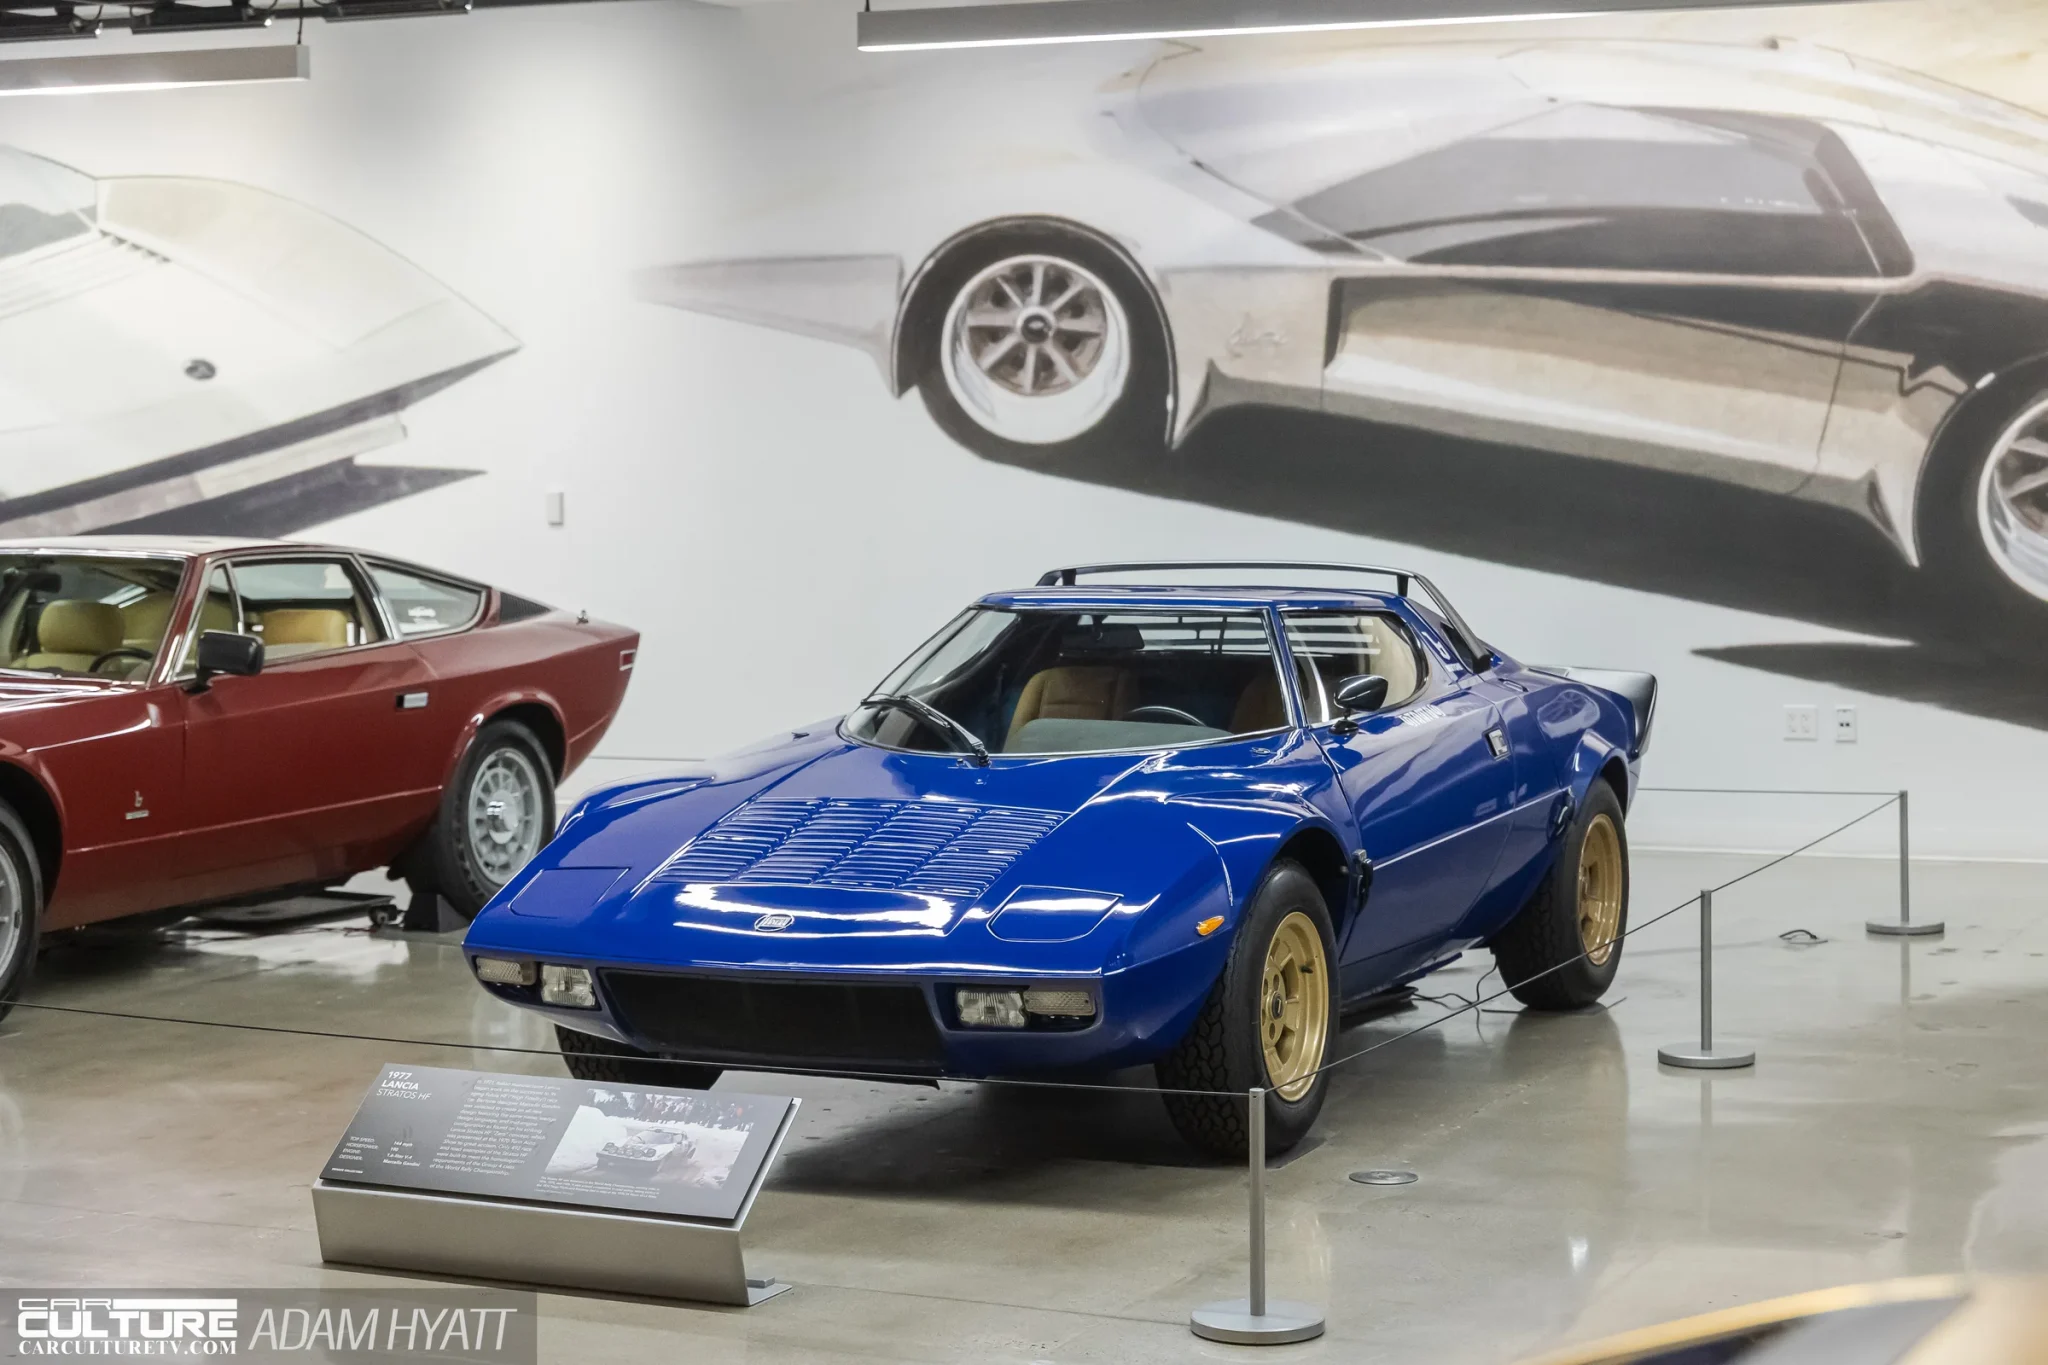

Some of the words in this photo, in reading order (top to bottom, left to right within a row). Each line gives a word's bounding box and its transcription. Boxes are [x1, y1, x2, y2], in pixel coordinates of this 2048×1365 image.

[387, 1071, 412, 1081] 1977
[381, 1080, 420, 1091] LANCIA
[376, 1088, 418, 1100] STRATOS
[418, 1092, 432, 1101] HF
